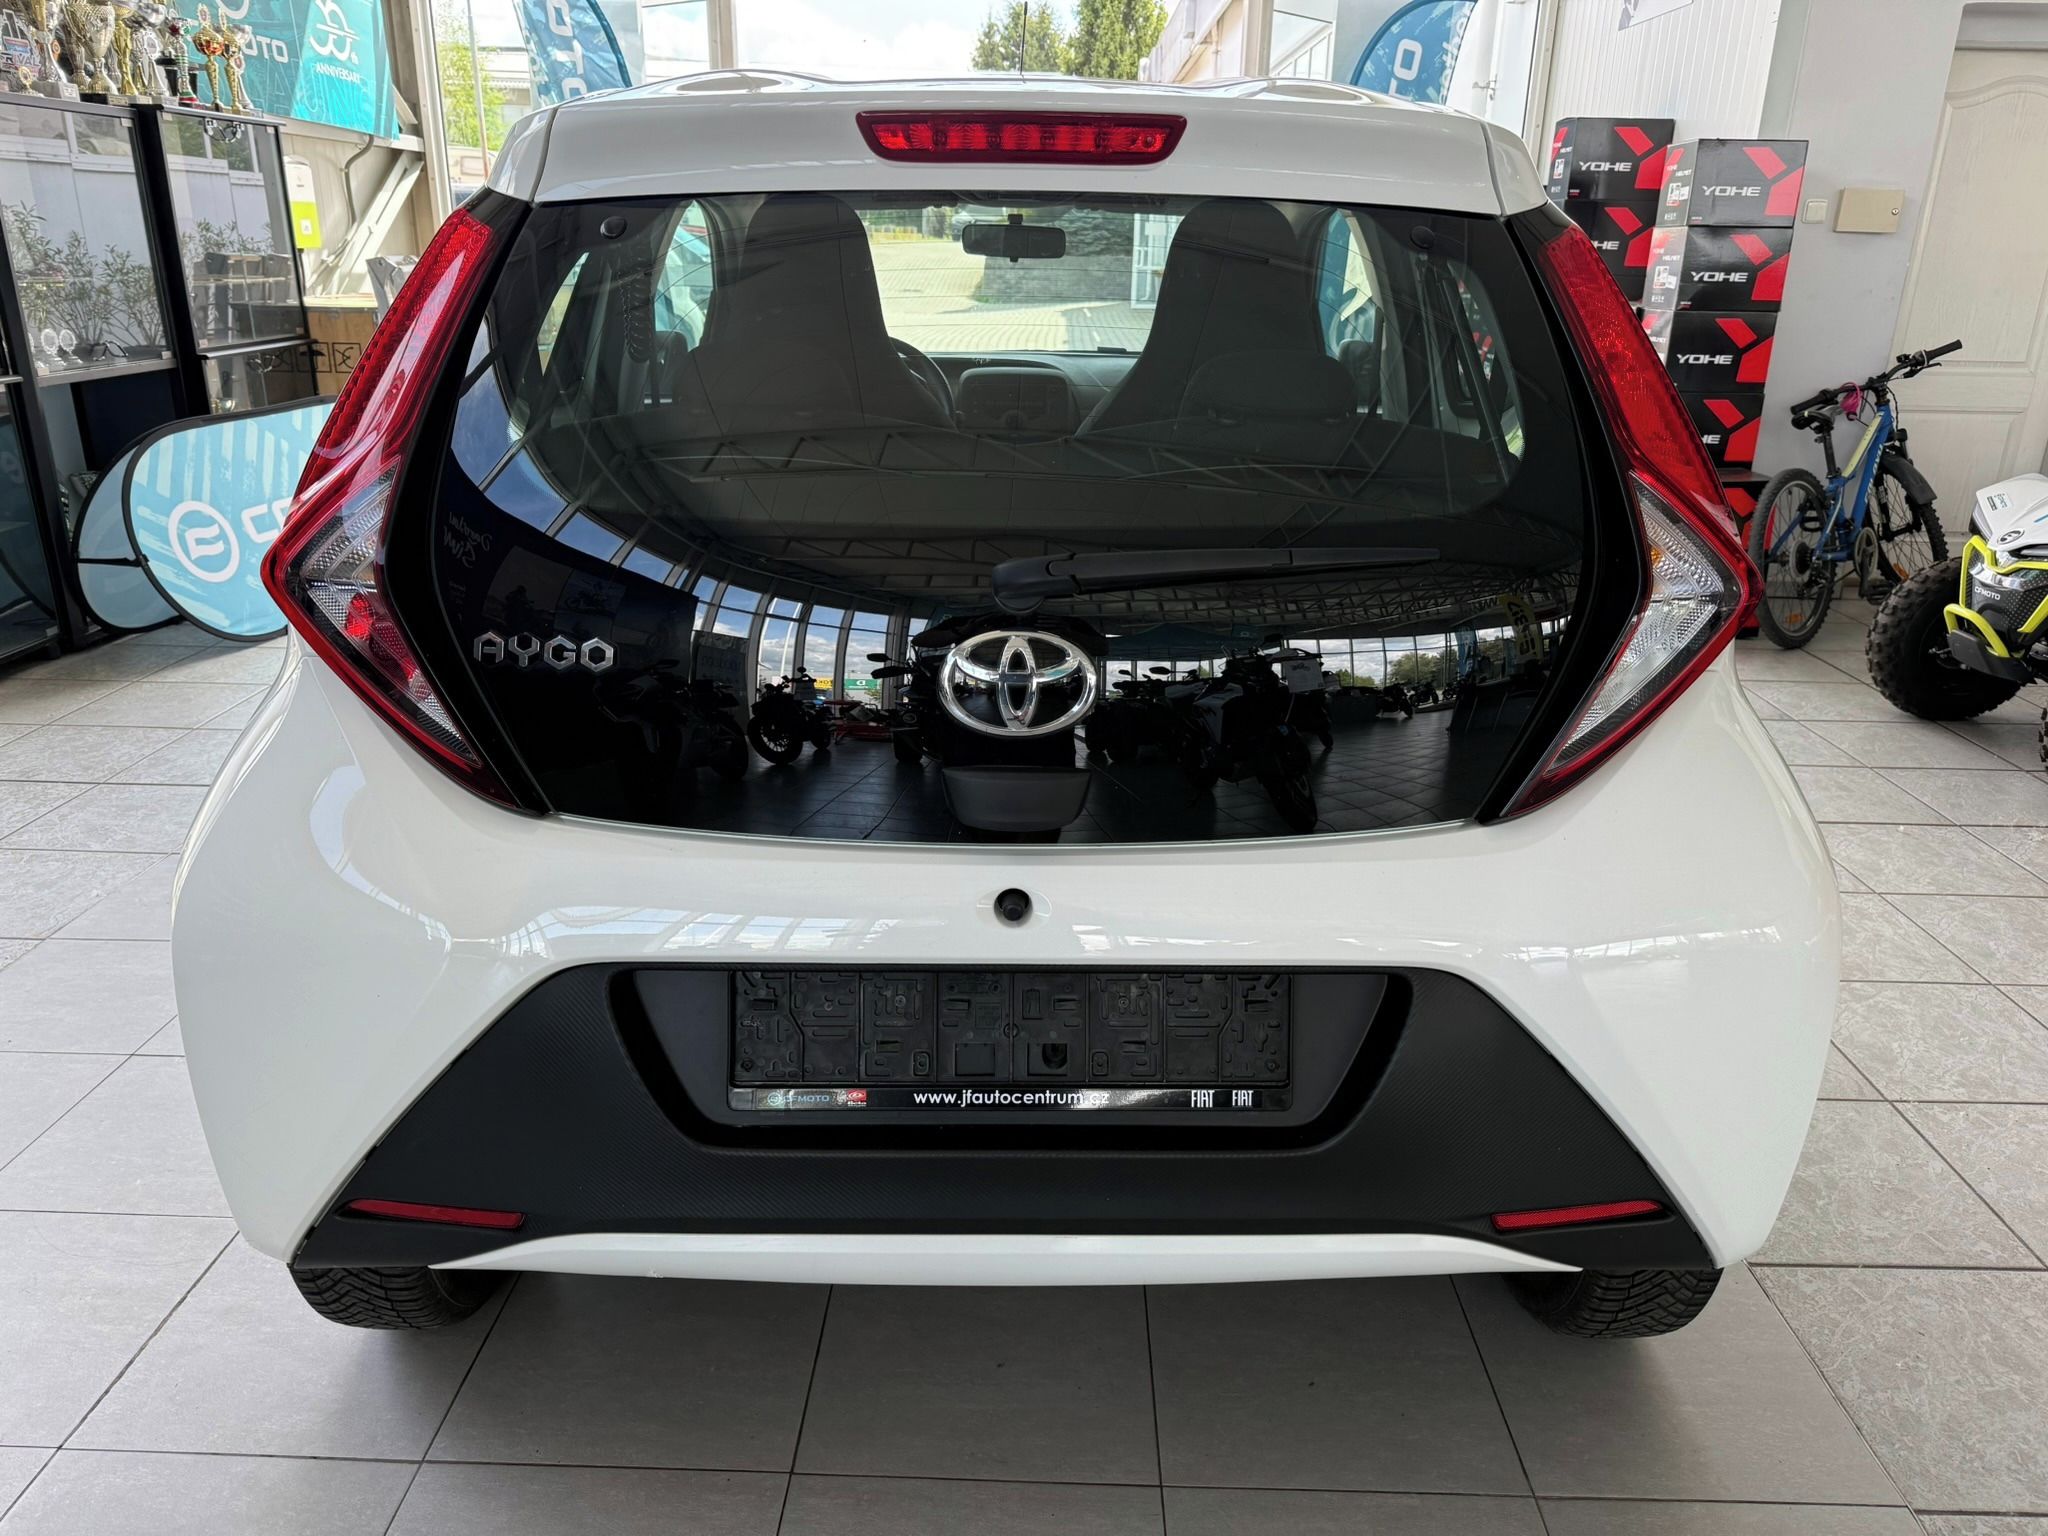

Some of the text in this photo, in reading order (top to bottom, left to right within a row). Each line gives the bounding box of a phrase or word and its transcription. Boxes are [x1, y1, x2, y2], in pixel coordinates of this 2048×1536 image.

[243, 34, 289, 63] OTO
[1579, 161, 1632, 172] YOHE
[1702, 185, 1761, 197] YOHE
[1594, 240, 1620, 250] HE
[1690, 271, 1749, 282] YOHE
[1676, 354, 1733, 364] YOHE
[1974, 585, 2001, 601] CFMOTO
[473, 631, 614, 673] AYGO
[913, 1089, 1110, 1108] www.jfautocentrum.cz
[1191, 1089, 1215, 1108] FIAT
[1232, 1089, 1254, 1106] FIAT
